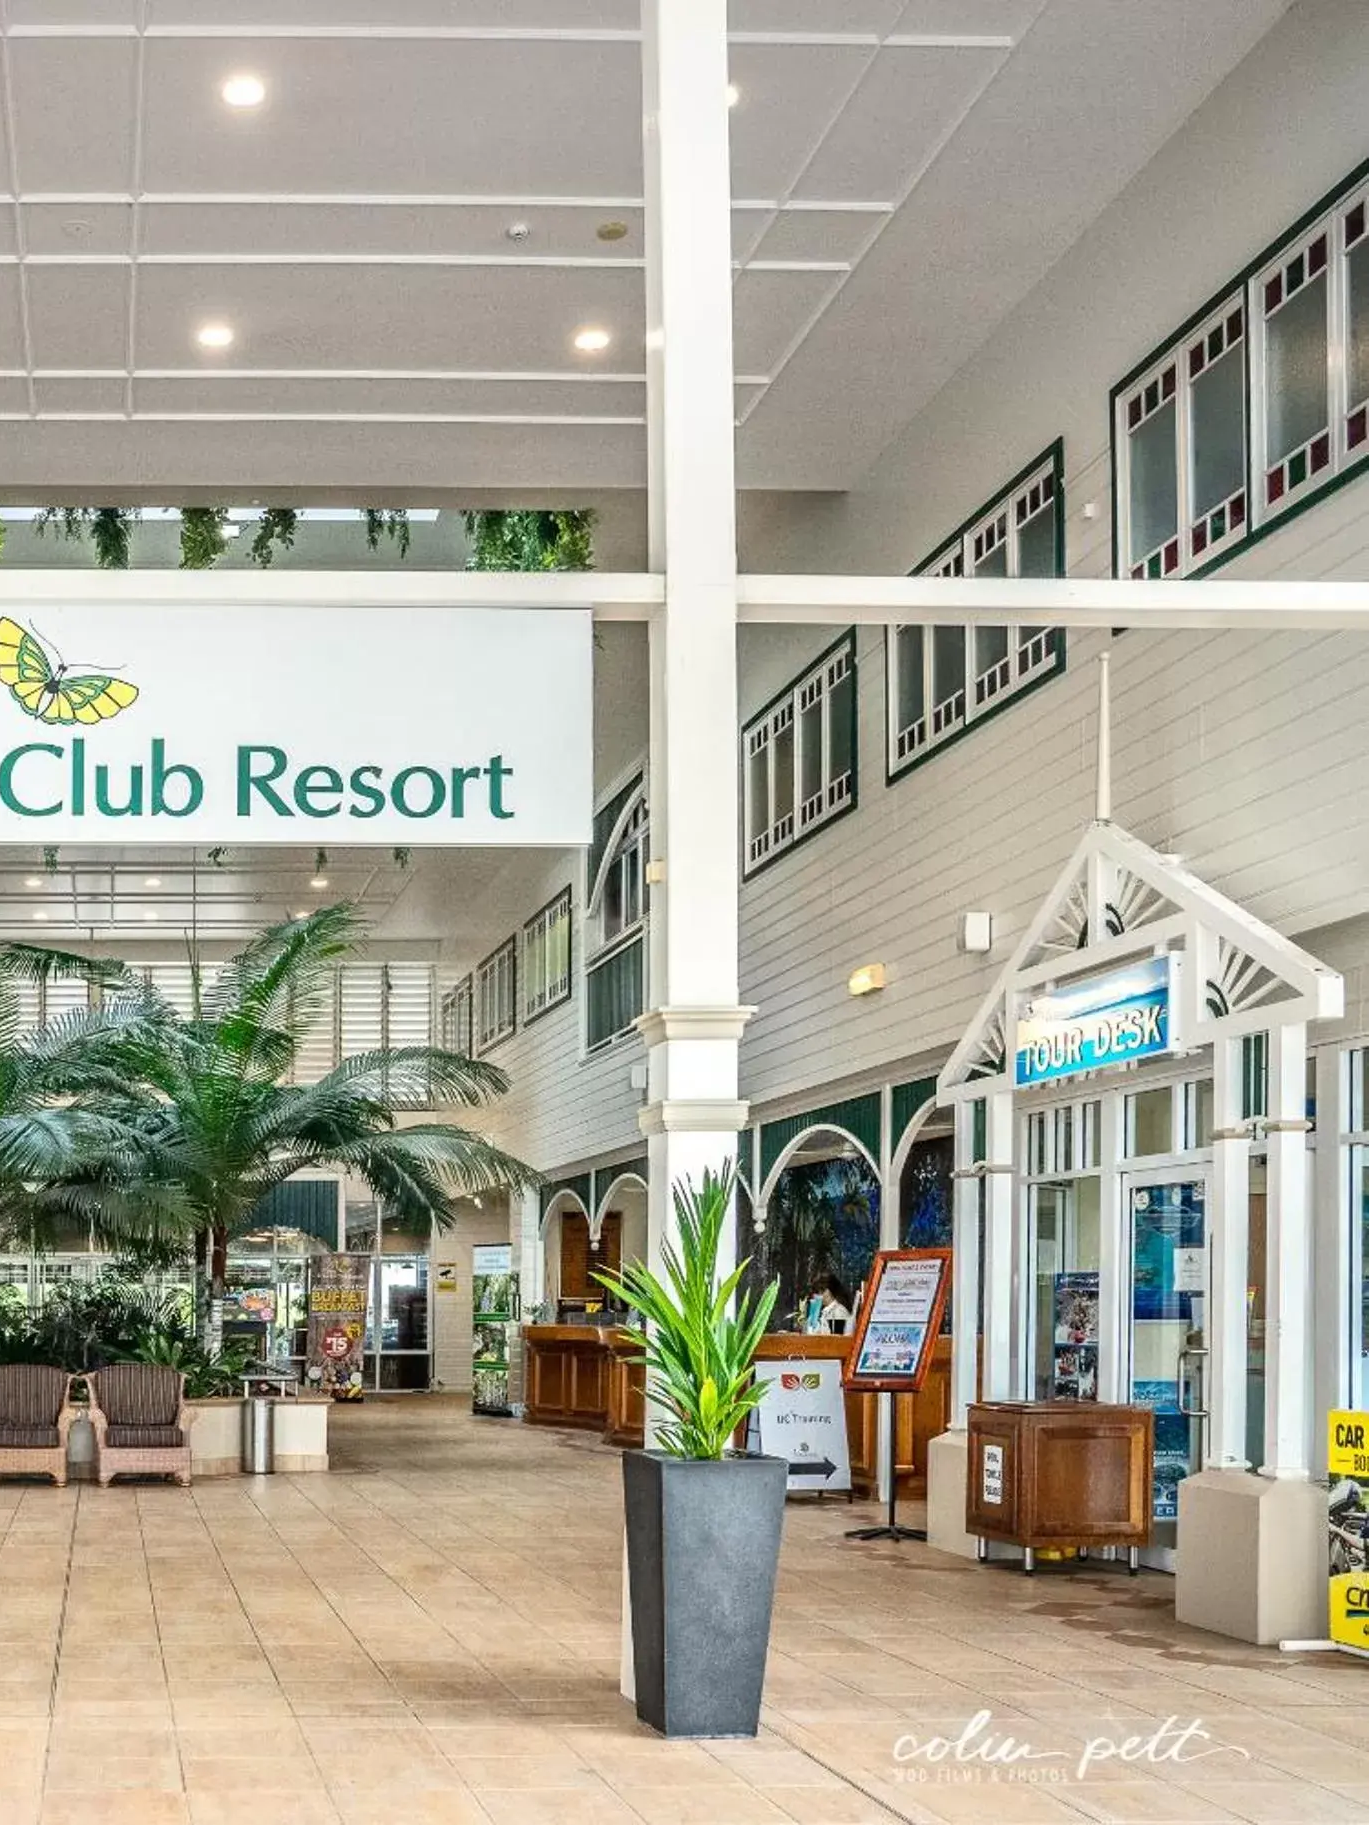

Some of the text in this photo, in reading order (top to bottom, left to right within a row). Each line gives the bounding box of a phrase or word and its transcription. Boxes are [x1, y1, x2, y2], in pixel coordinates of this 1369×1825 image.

[235, 744, 515, 820] Resort
[1023, 1004, 1164, 1076] TOUR DESK
[311, 1291, 365, 1302] BUFFET
[1335, 1423, 1364, 1450] CAR
